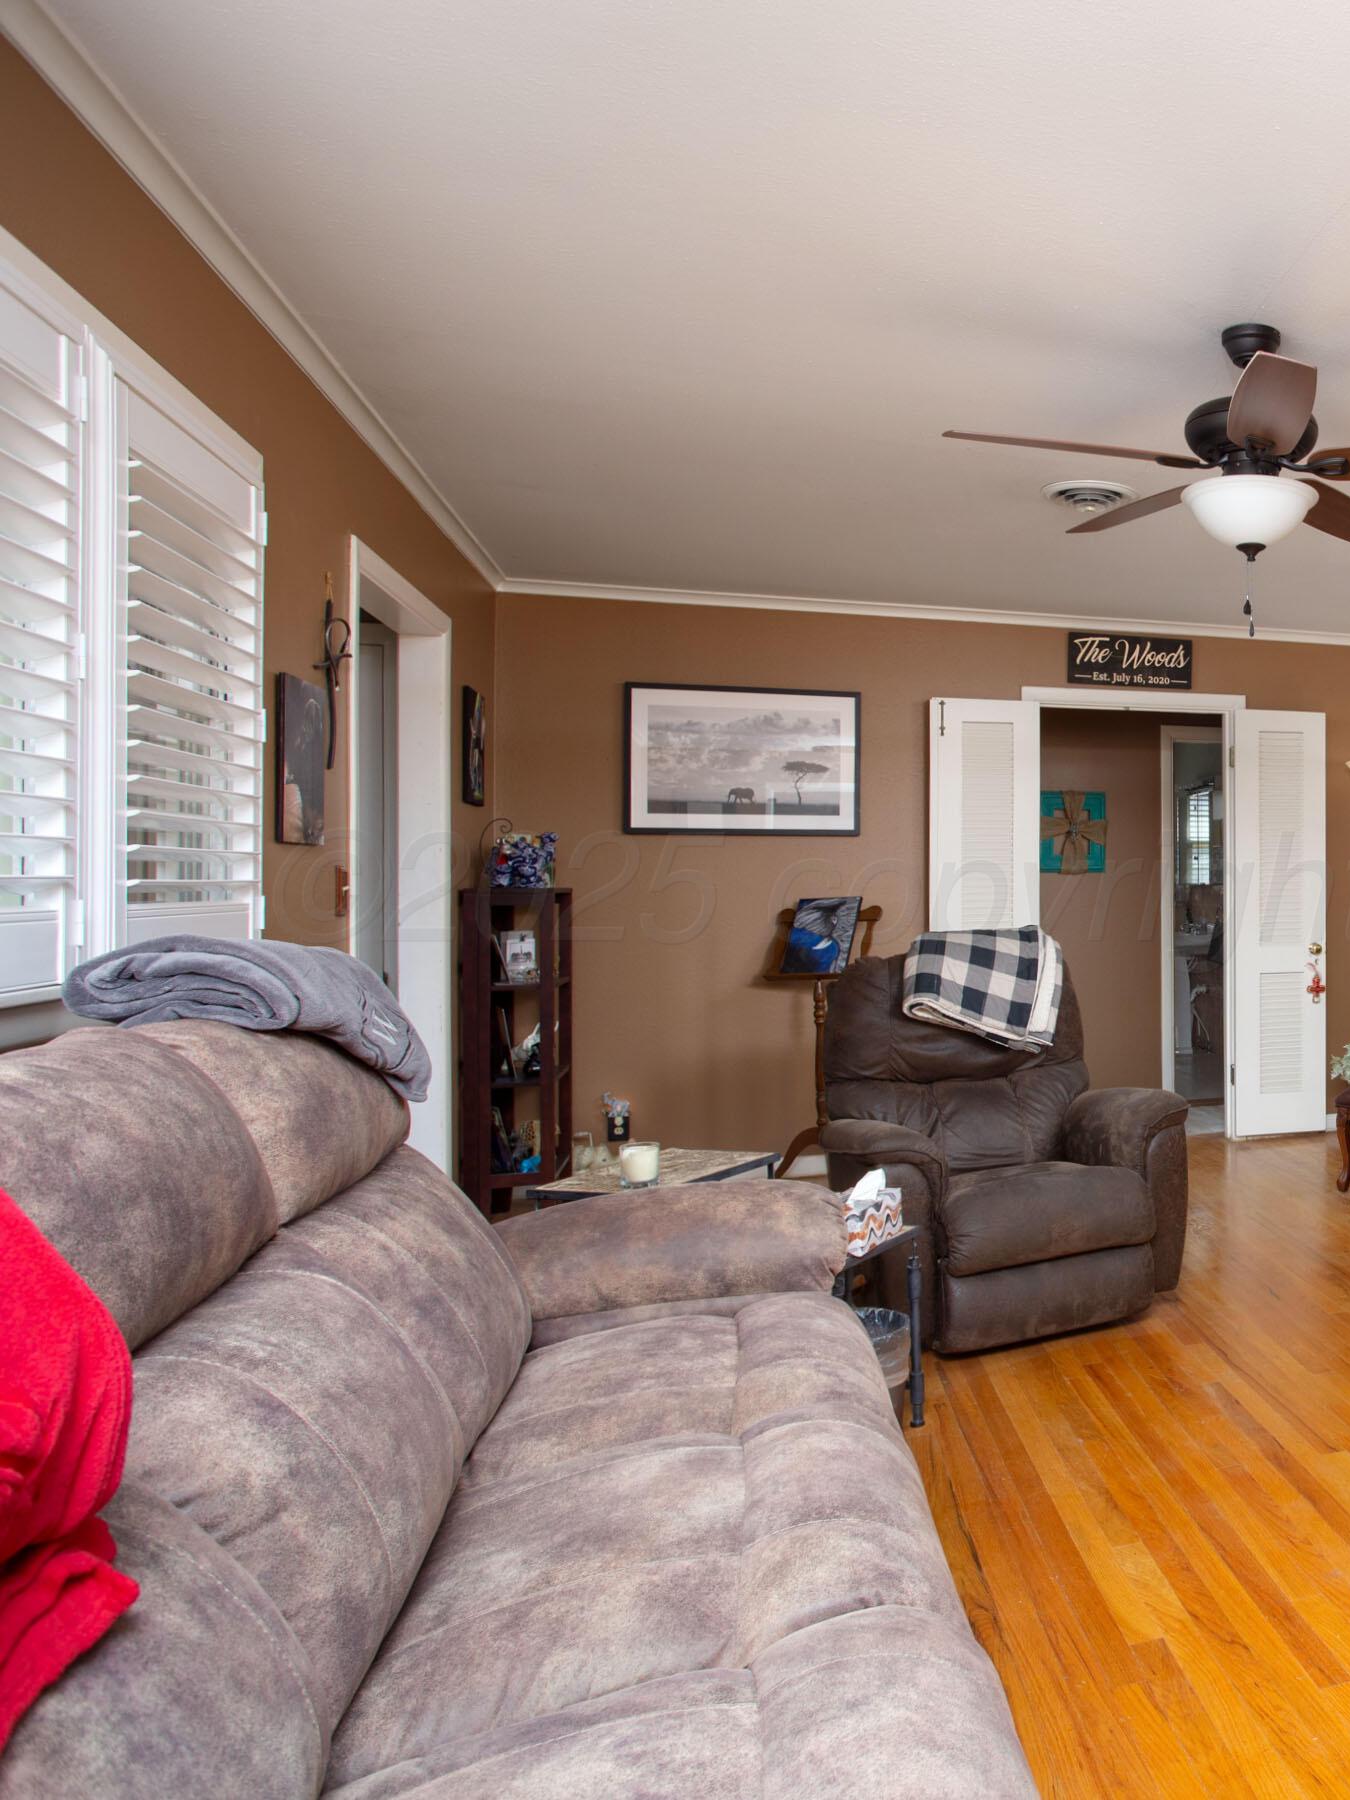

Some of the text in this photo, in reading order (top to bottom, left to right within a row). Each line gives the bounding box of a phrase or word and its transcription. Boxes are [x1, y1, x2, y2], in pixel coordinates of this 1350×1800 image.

[1073, 636, 1190, 669] The Woods
[1092, 671, 1111, 681] Est.
[1111, 672, 1131, 685] July
[1147, 675, 1170, 685] 2020
